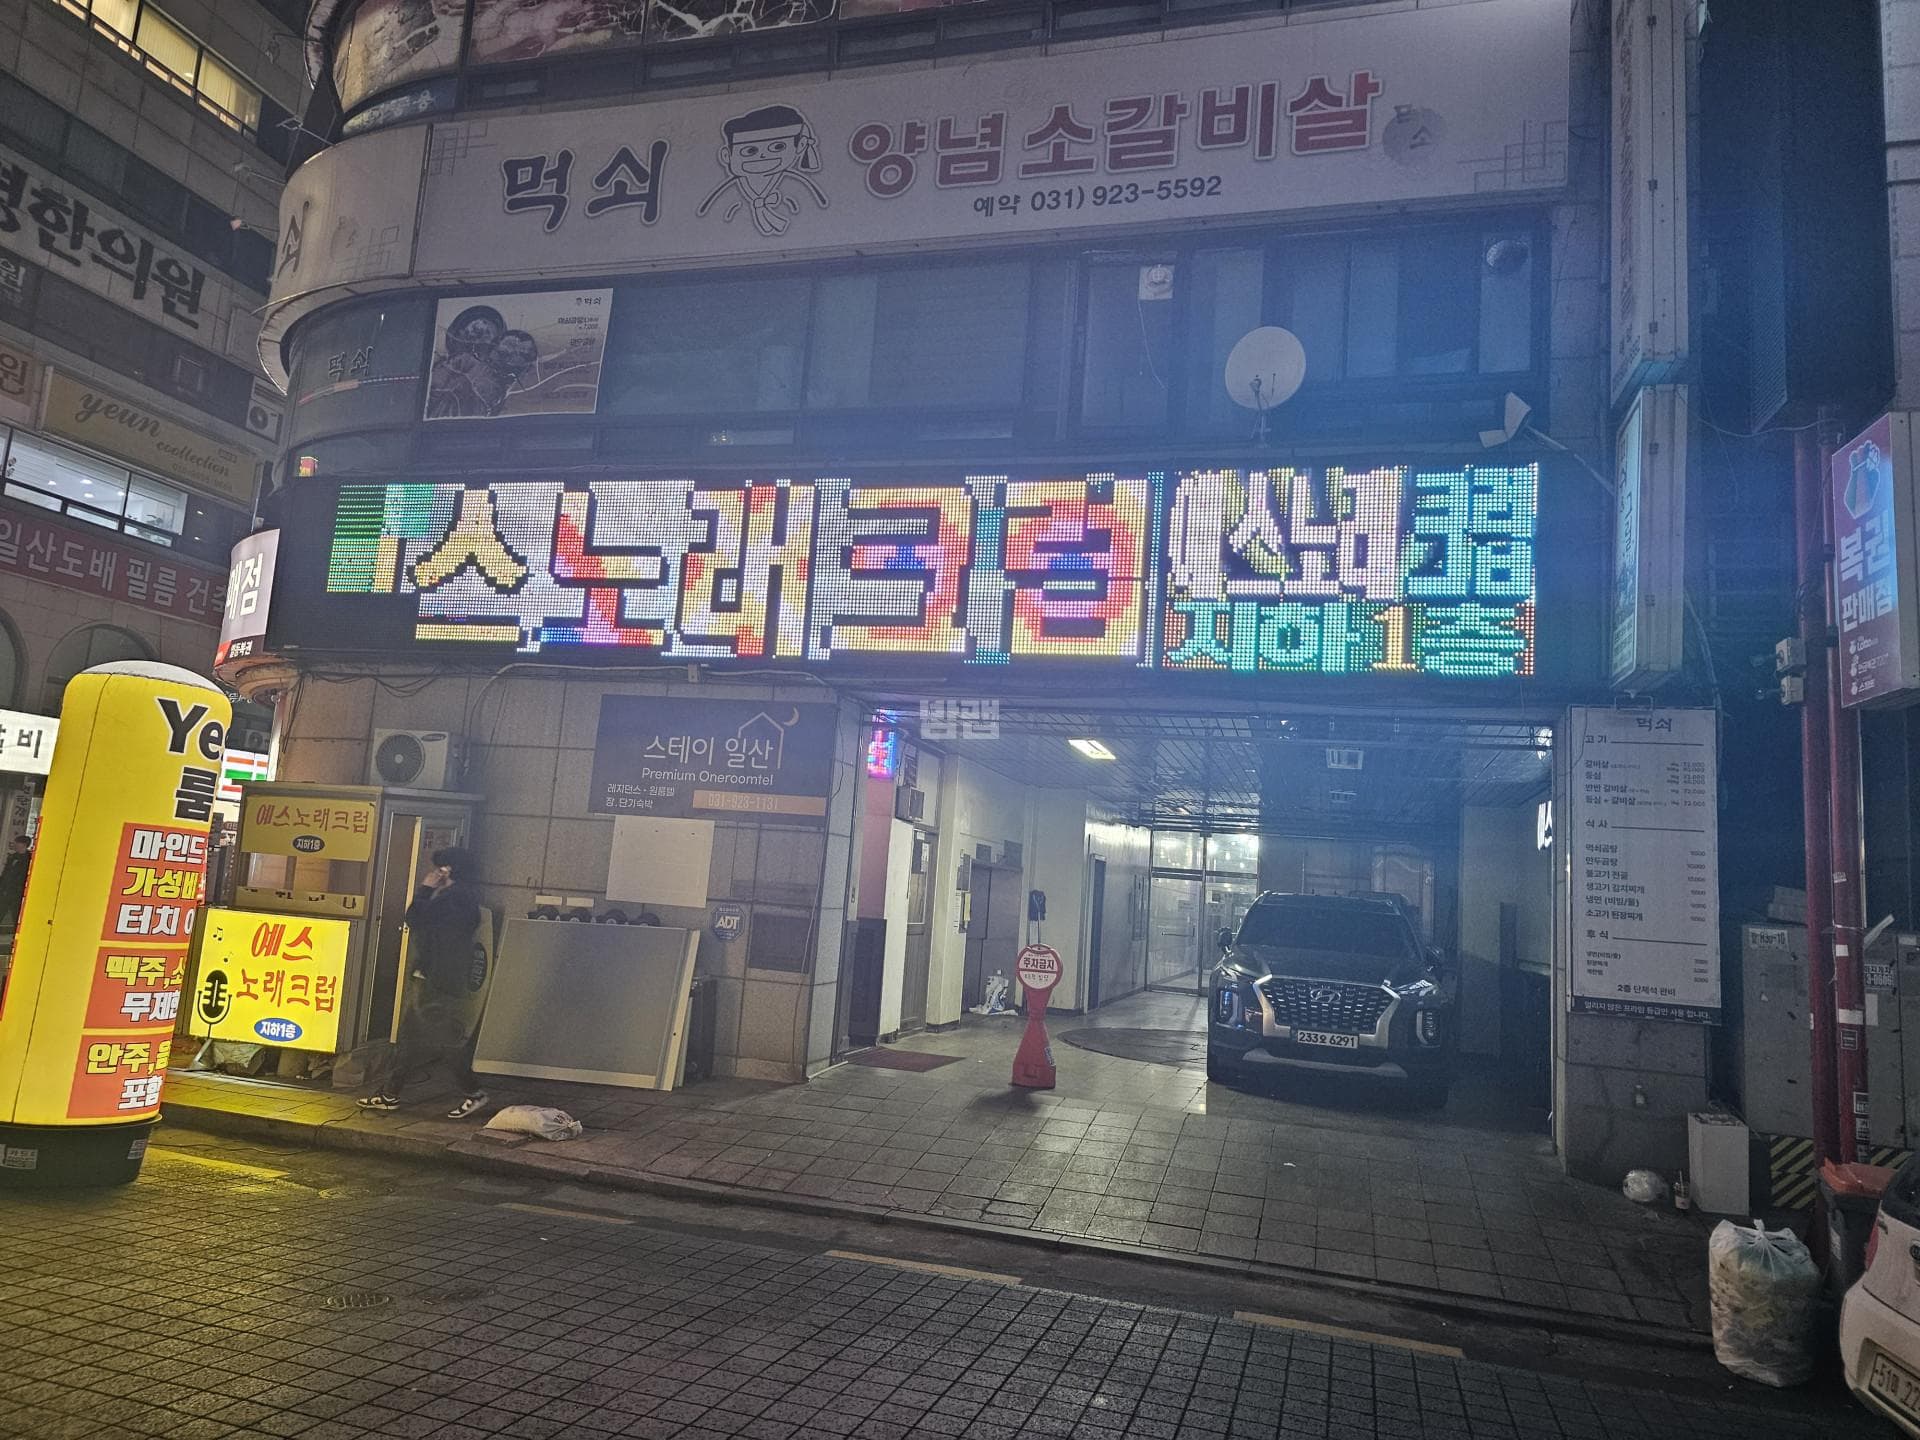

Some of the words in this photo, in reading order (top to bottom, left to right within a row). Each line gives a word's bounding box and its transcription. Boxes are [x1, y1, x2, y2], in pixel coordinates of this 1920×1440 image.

[502, 139, 672, 233] 먹쇠
[973, 193, 1020, 217] 예약
[75, 393, 161, 438] yeun
[0, 518, 118, 592] 일산도배
[125, 557, 177, 608] 필름
[1840, 510, 1893, 583] 복권
[1841, 576, 1893, 634] 판매점
[157, 697, 228, 764] Ye
[1635, 717, 1673, 732] 먹쇠
[642, 735, 715, 766] 스테이
[724, 737, 775, 769] 일산
[642, 767, 696, 782] Premium
[699, 770, 774, 786] Oneroomtel
[255, 803, 370, 834] 예스노래크럽
[115, 903, 181, 936] 터치
[715, 915, 740, 930] ADT
[250, 921, 313, 961] 예스
[1023, 957, 1055, 970] 주차금지
[235, 967, 337, 1013] 노래크럽
[260, 1020, 297, 1039] 지하1층
[1328, 1033, 1356, 1048] 6291
[117, 1075, 163, 1110] 포함
